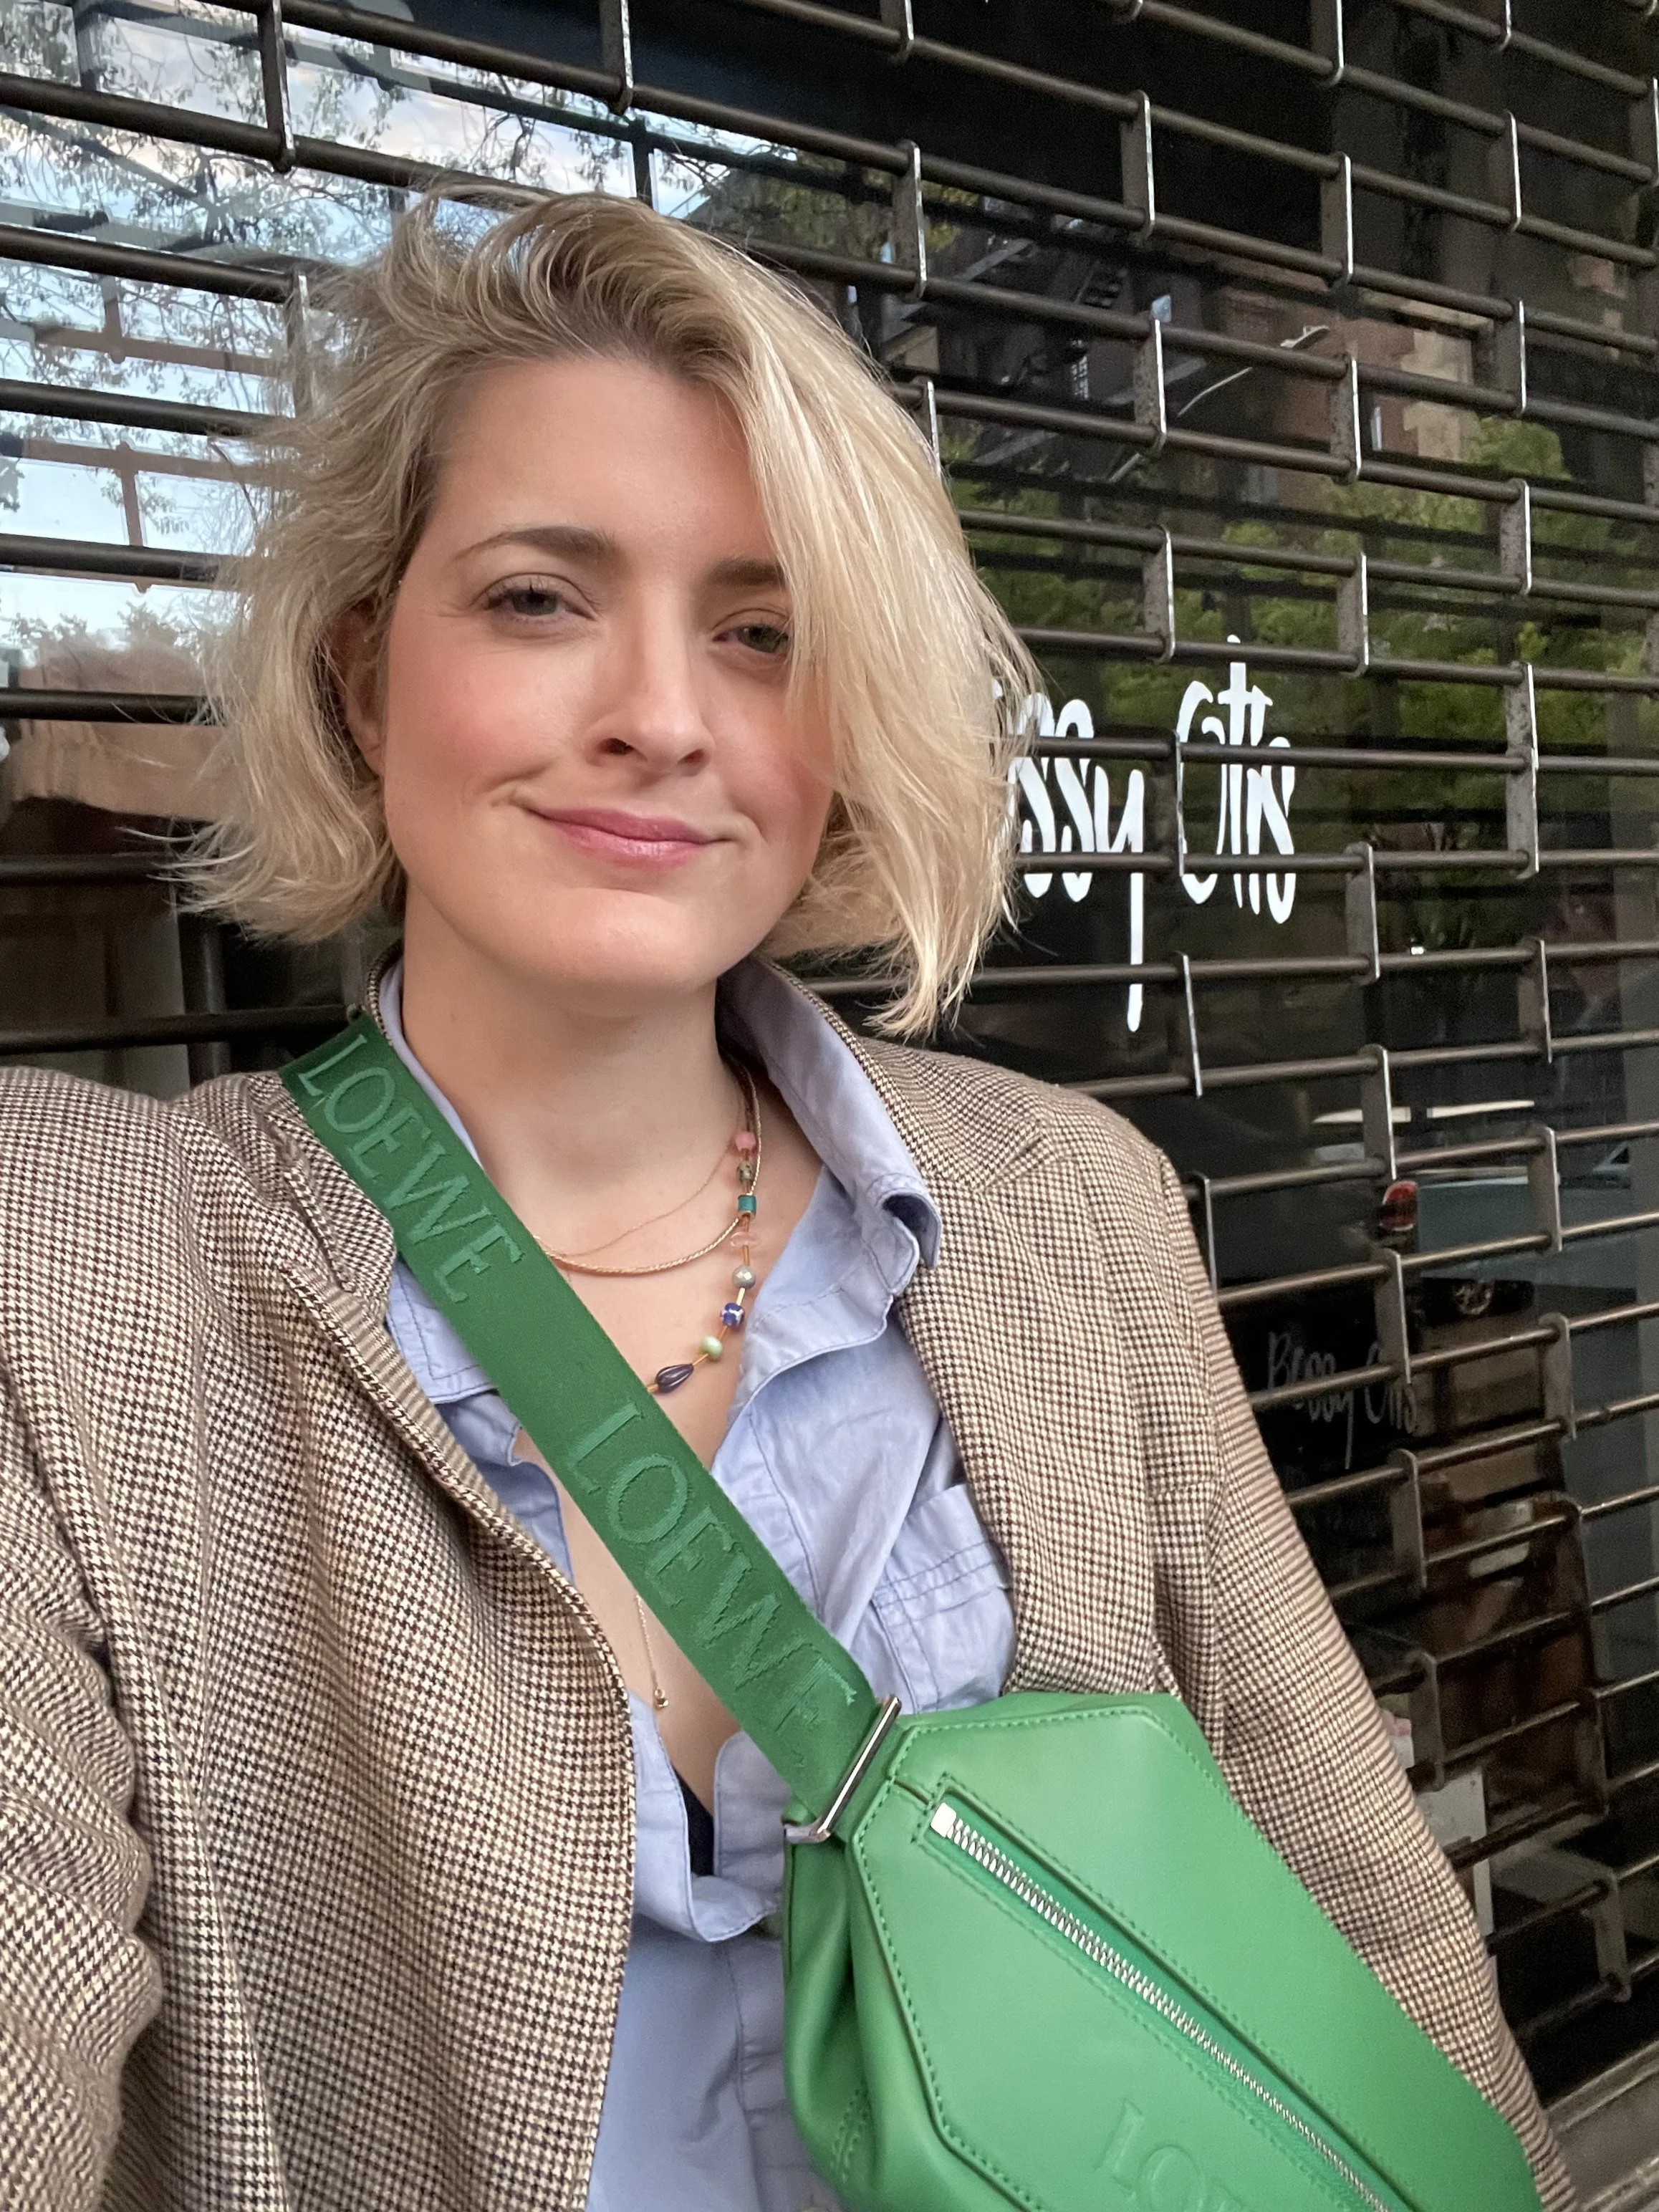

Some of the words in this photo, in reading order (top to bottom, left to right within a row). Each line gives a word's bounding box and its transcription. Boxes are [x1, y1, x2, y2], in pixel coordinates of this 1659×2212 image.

[991, 679, 1145, 1033] ssy
[298, 1034, 524, 1302] LOEWE
[567, 1401, 857, 1768] LOEWE
[1092, 2097, 1245, 2212] LO
